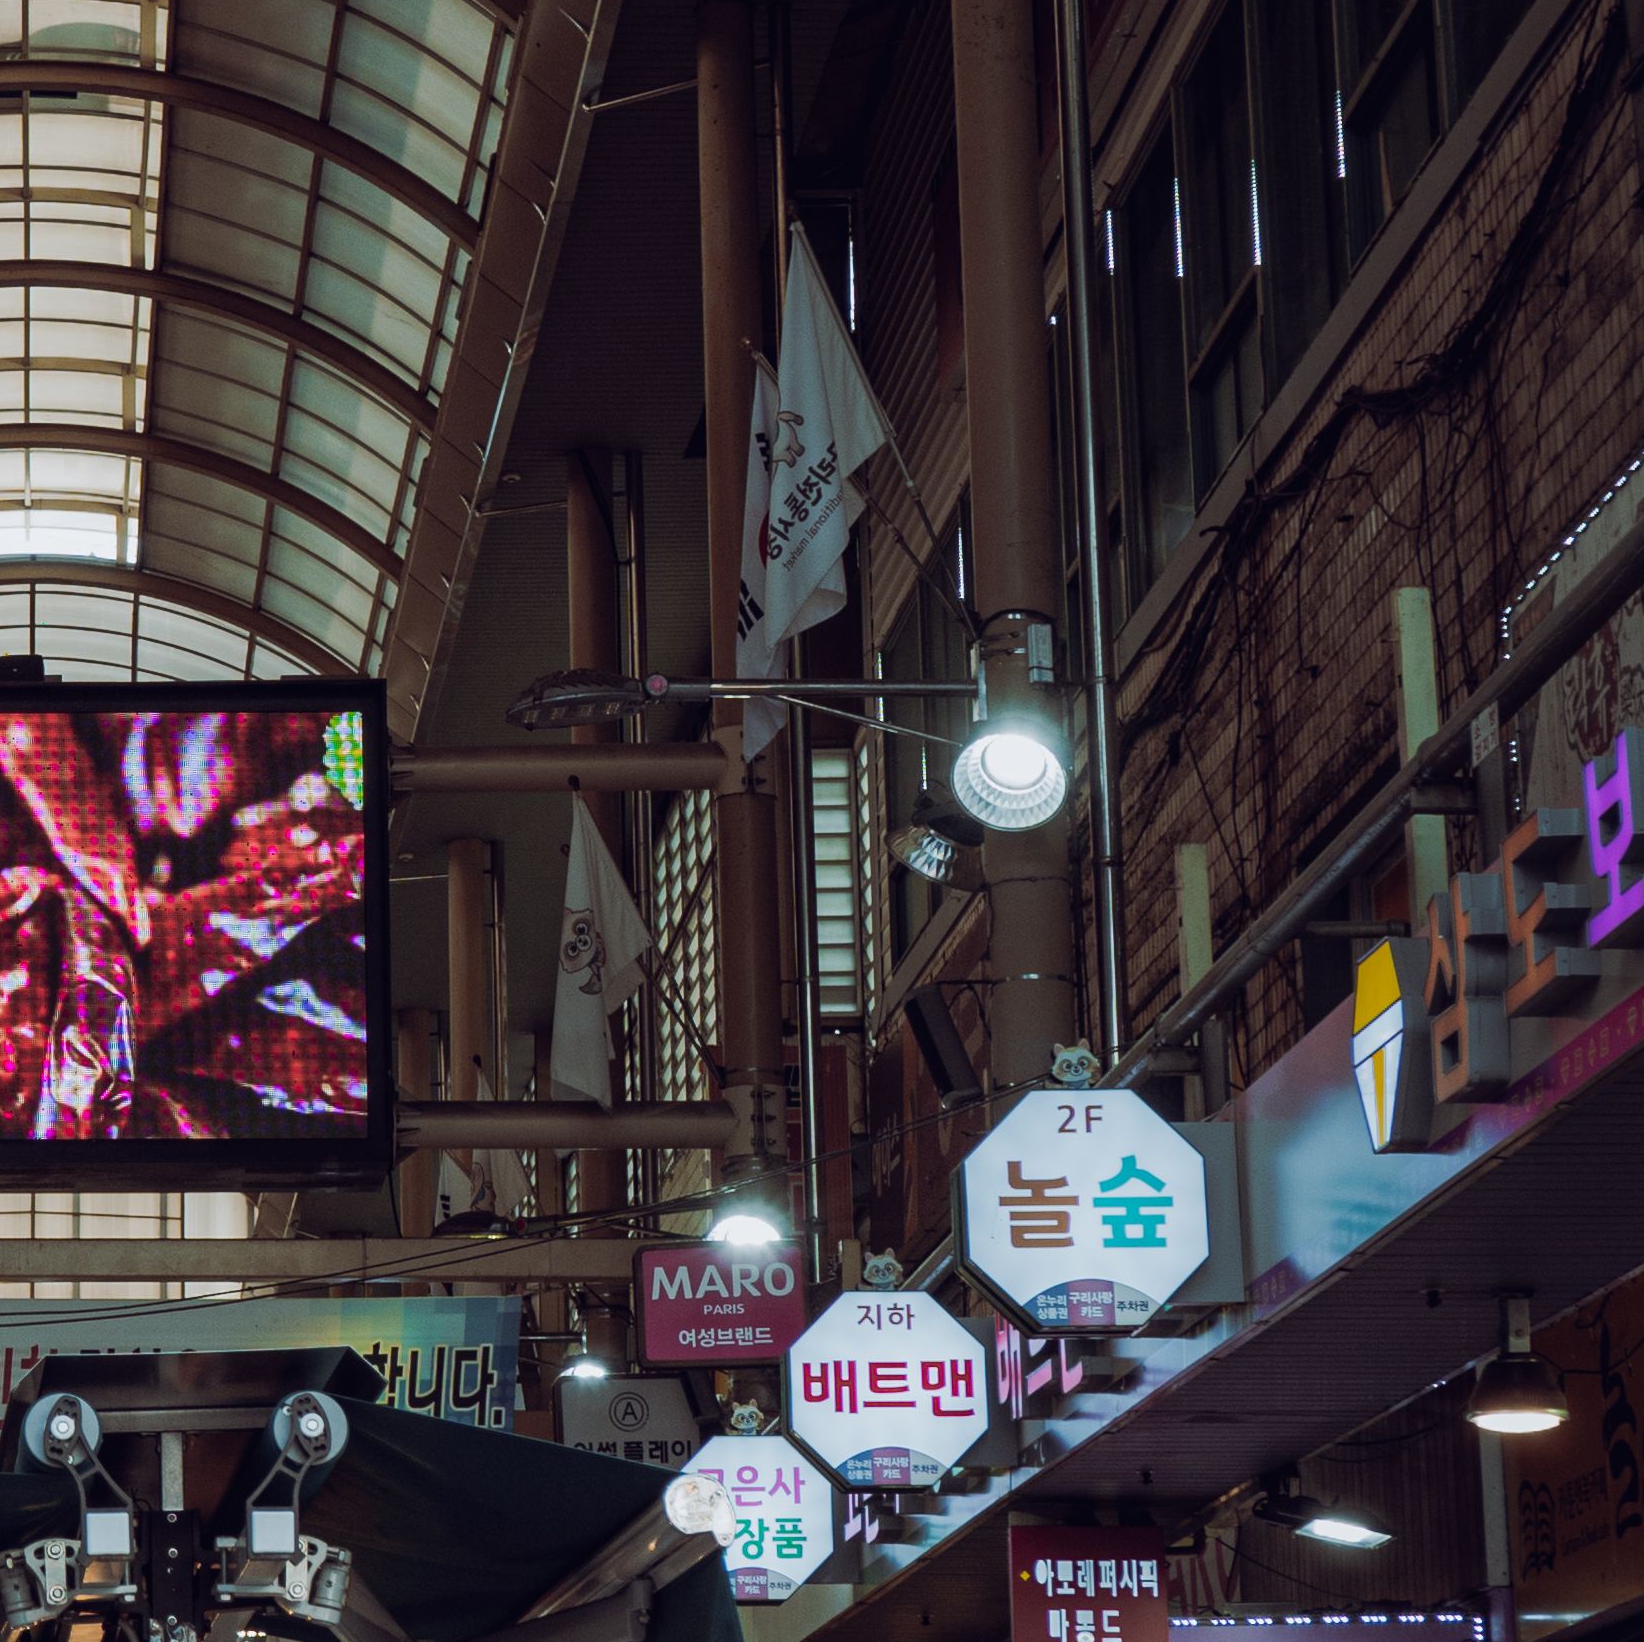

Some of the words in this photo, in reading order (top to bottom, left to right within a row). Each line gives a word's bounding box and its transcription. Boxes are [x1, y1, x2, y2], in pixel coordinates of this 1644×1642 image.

[1057, 1105, 1103, 1133] 2F
[999, 1155, 1173, 1249] 놀숲
[651, 1261, 796, 1301] MARO
[703, 1303, 746, 1315] PARIS
[1036, 1294, 1067, 1307] 온누리
[1069, 1291, 1113, 1306] 구리사랑
[1037, 1306, 1069, 1320] 상품권
[1080, 1306, 1104, 1319] 카드
[1117, 1298, 1149, 1313] 주차권
[857, 1303, 916, 1331] 지하
[678, 1326, 774, 1349] 여성브랜드
[802, 1359, 976, 1417] 배트맨
[873, 1456, 909, 1470] 구리사랑
[882, 1469, 902, 1480] 카드
[912, 1464, 939, 1476] 주차권
[734, 1518, 806, 1559] 장품
